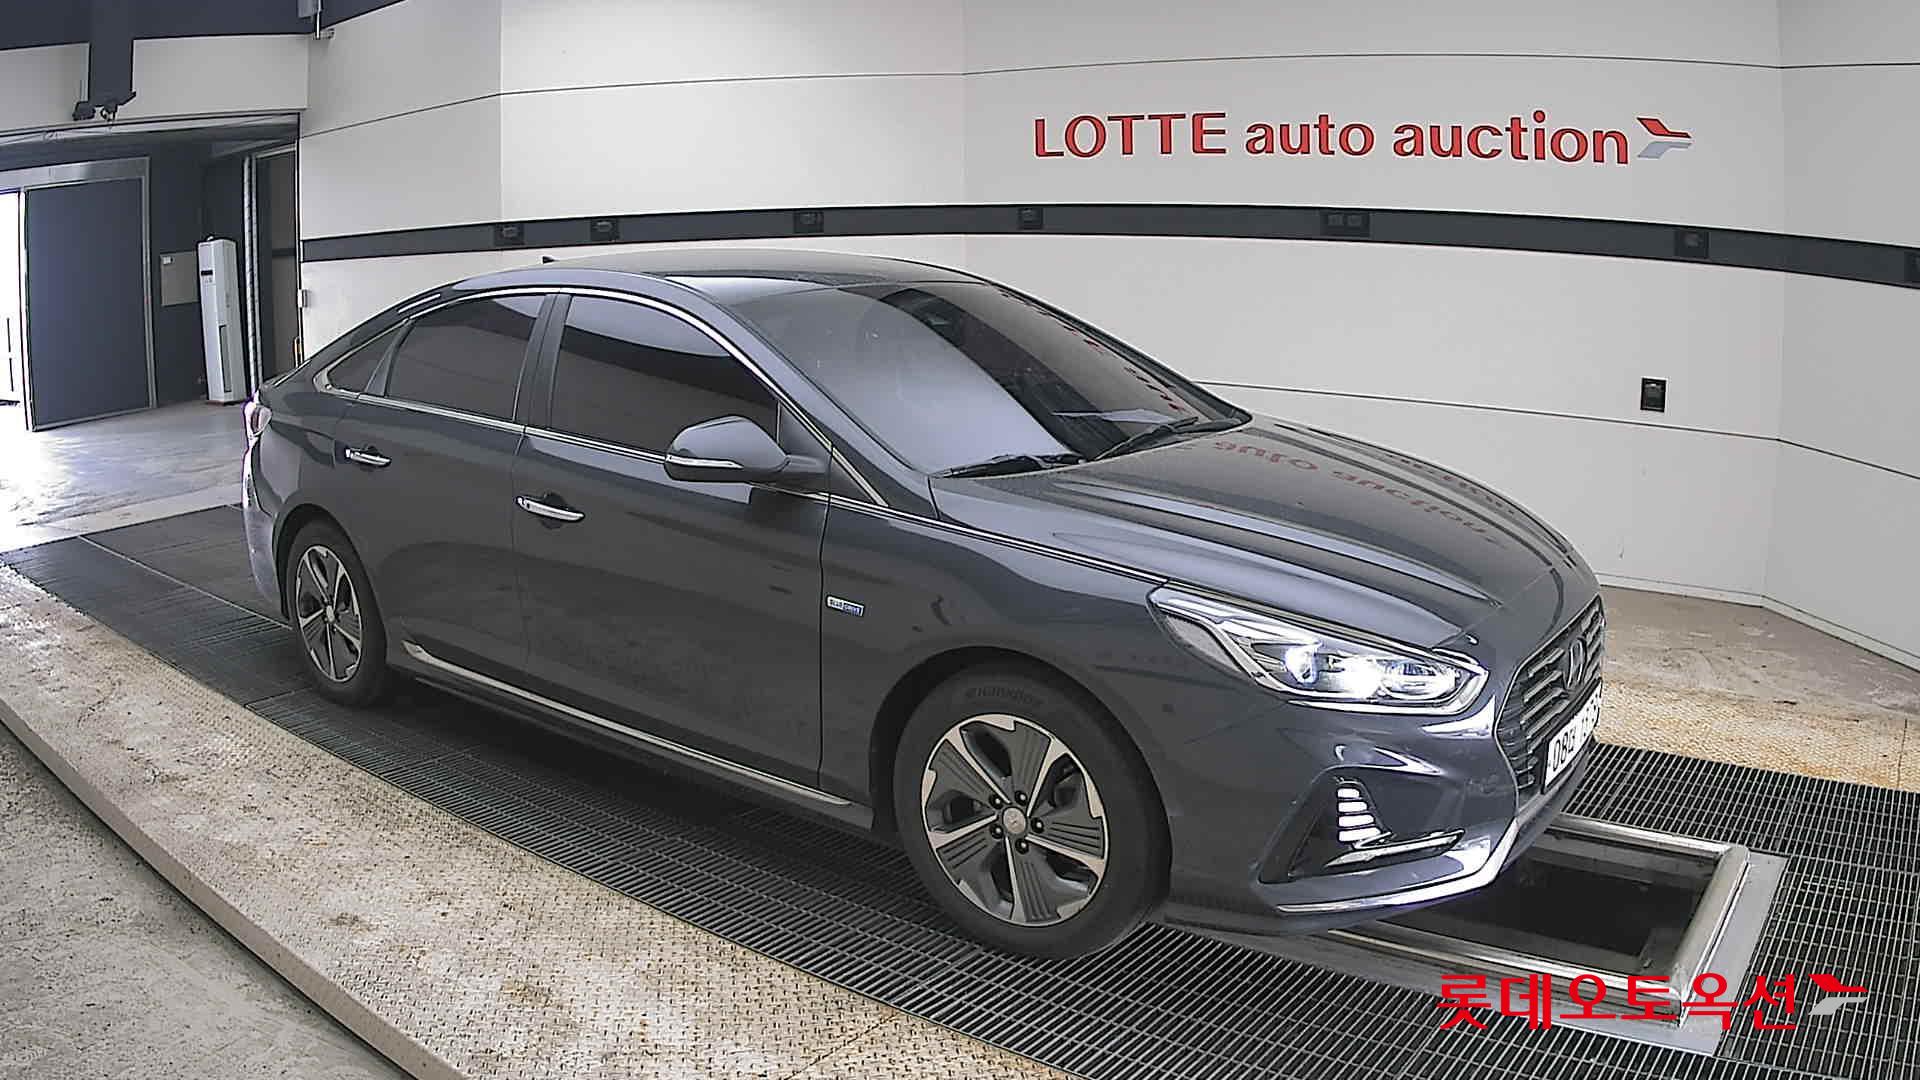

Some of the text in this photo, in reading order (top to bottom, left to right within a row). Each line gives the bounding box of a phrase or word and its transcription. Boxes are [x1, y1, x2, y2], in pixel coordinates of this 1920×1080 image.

[1034, 109, 1629, 165] LOTTE auto auction
